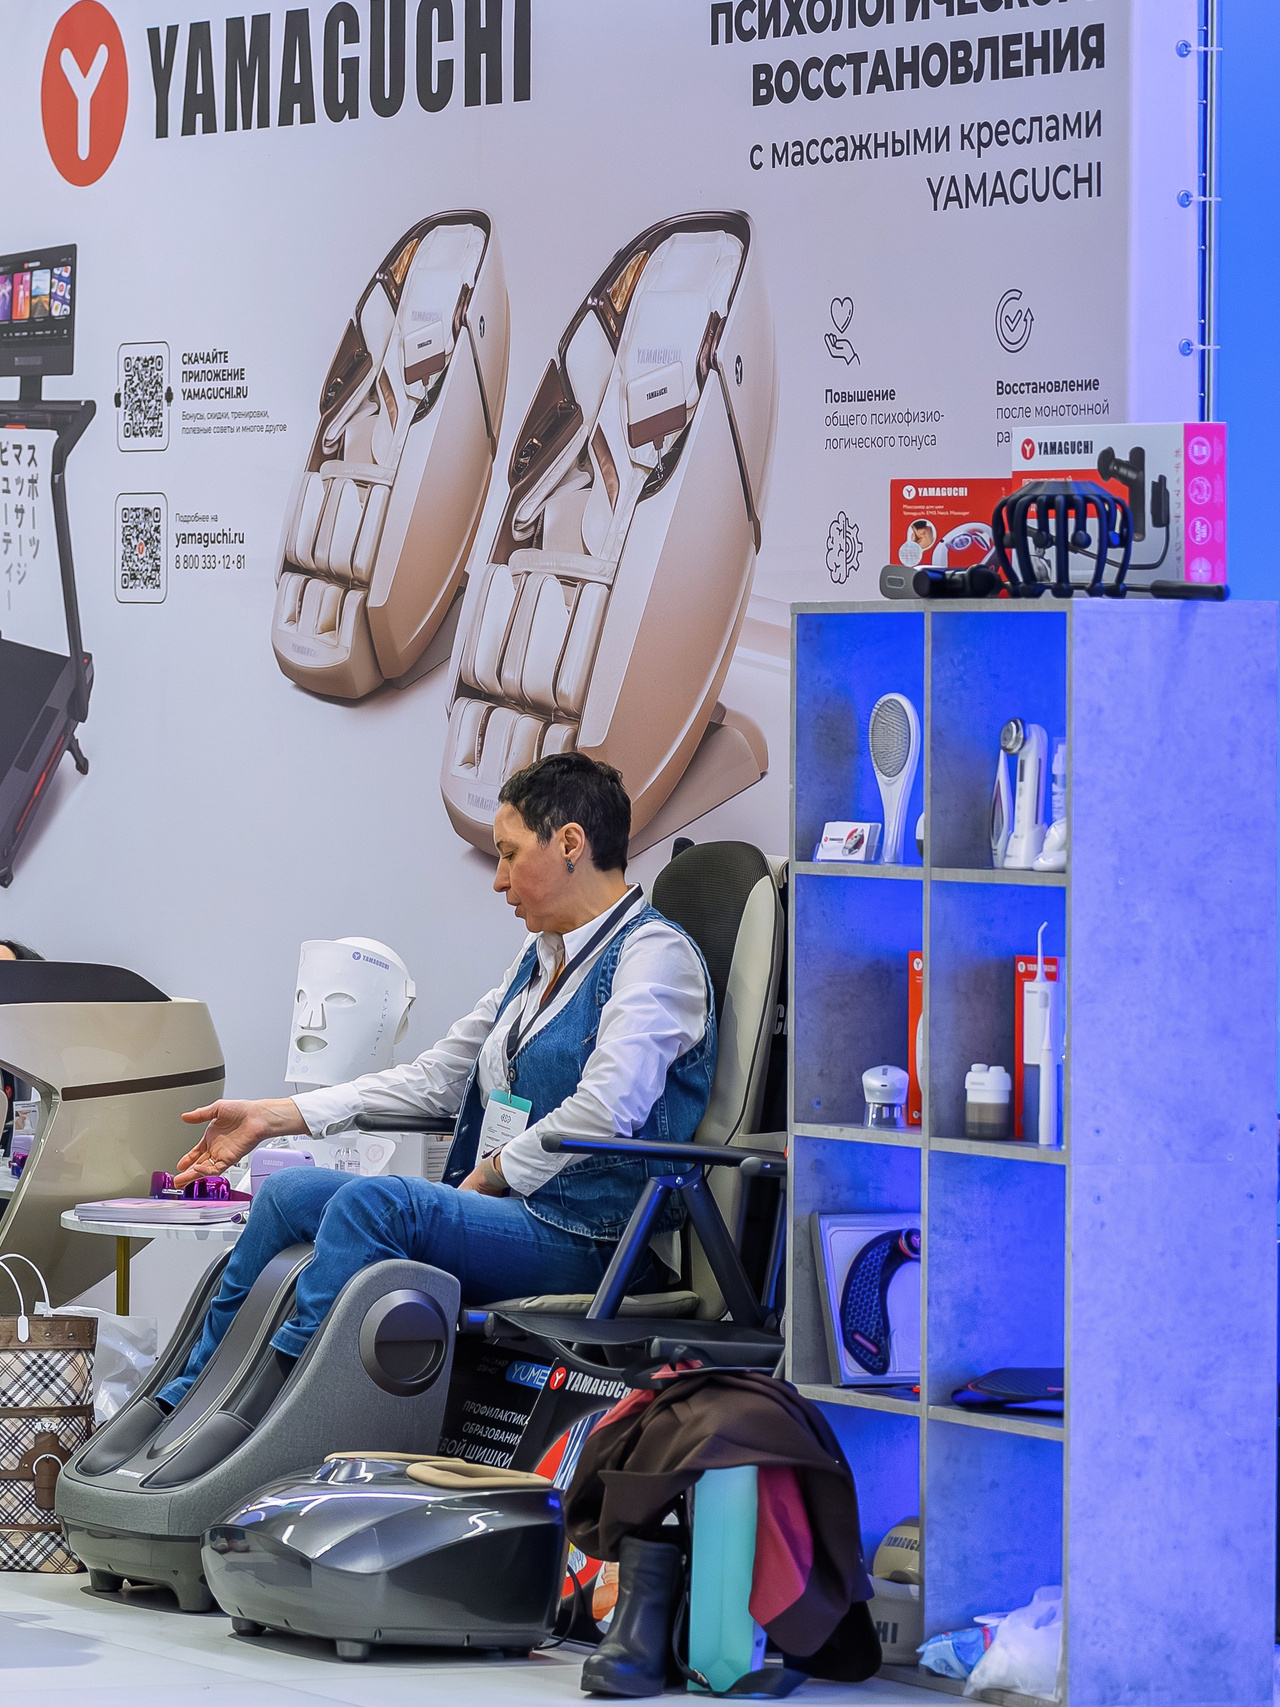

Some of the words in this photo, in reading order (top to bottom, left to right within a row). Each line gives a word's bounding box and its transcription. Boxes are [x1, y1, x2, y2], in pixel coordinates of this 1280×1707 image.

[147, 0, 531, 139] YAMAGUCHI
[752, 22, 1105, 107] ВОССТАНОВЛЕНИЯ
[749, 144, 763, 170] с
[771, 125, 951, 169] массажными
[960, 109, 1102, 158] креслами
[926, 161, 1102, 212] YAMAGUCHI
[181, 348, 229, 365] СКАЧАЙТЕ
[181, 368, 245, 383] ПРИЛОЖЕНИЕ
[181, 386, 249, 401] YAMAGUCHI.RU
[824, 387, 896, 404] Повышение
[996, 377, 1100, 396] Восстановление
[824, 411, 868, 427] общего
[870, 407, 945, 426] психофизио-
[996, 404, 1032, 420] после
[1034, 398, 1110, 418] монотонной
[824, 436, 896, 451] логического
[898, 434, 937, 451] тонуса
[1038, 440, 1093, 455] YAMAGUCHI
[918, 487, 968, 497] YAMAGUCHI
[175, 528, 245, 548] yamaguchi.ru
[175, 555, 181, 569] 8
[183, 555, 199, 569] 800
[464, 1443, 514, 1470] ШИШКИ
